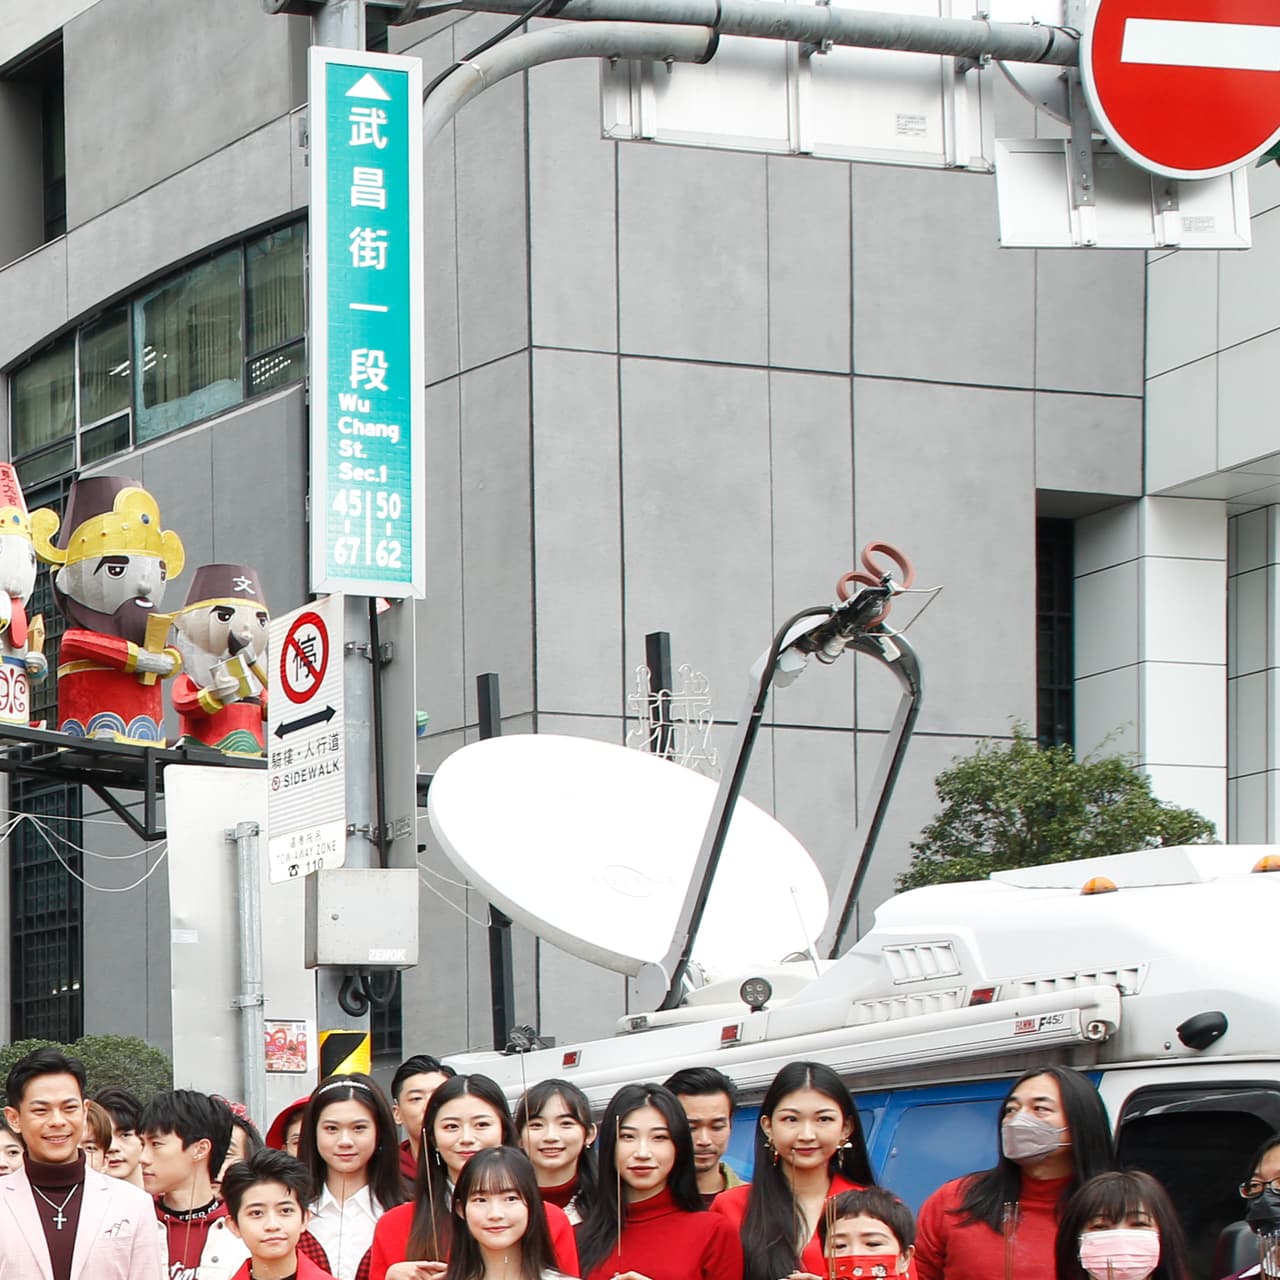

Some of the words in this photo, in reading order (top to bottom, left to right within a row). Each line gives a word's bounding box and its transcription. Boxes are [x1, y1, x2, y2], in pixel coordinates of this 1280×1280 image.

[348, 105, 389, 393] 武昌街一段
[339, 392, 370, 413] Wu
[338, 416, 400, 443] Chang
[338, 440, 367, 460] St.
[338, 463, 388, 483] Sec.1
[333, 487, 362, 518] 45
[375, 491, 401, 520] 50
[333, 536, 359, 567] 67
[374, 539, 402, 569] 62
[232, 575, 256, 595] 文
[283, 758, 340, 789] SIDEWALK
[316, 839, 337, 856] ZONE
[305, 857, 324, 873] 110
